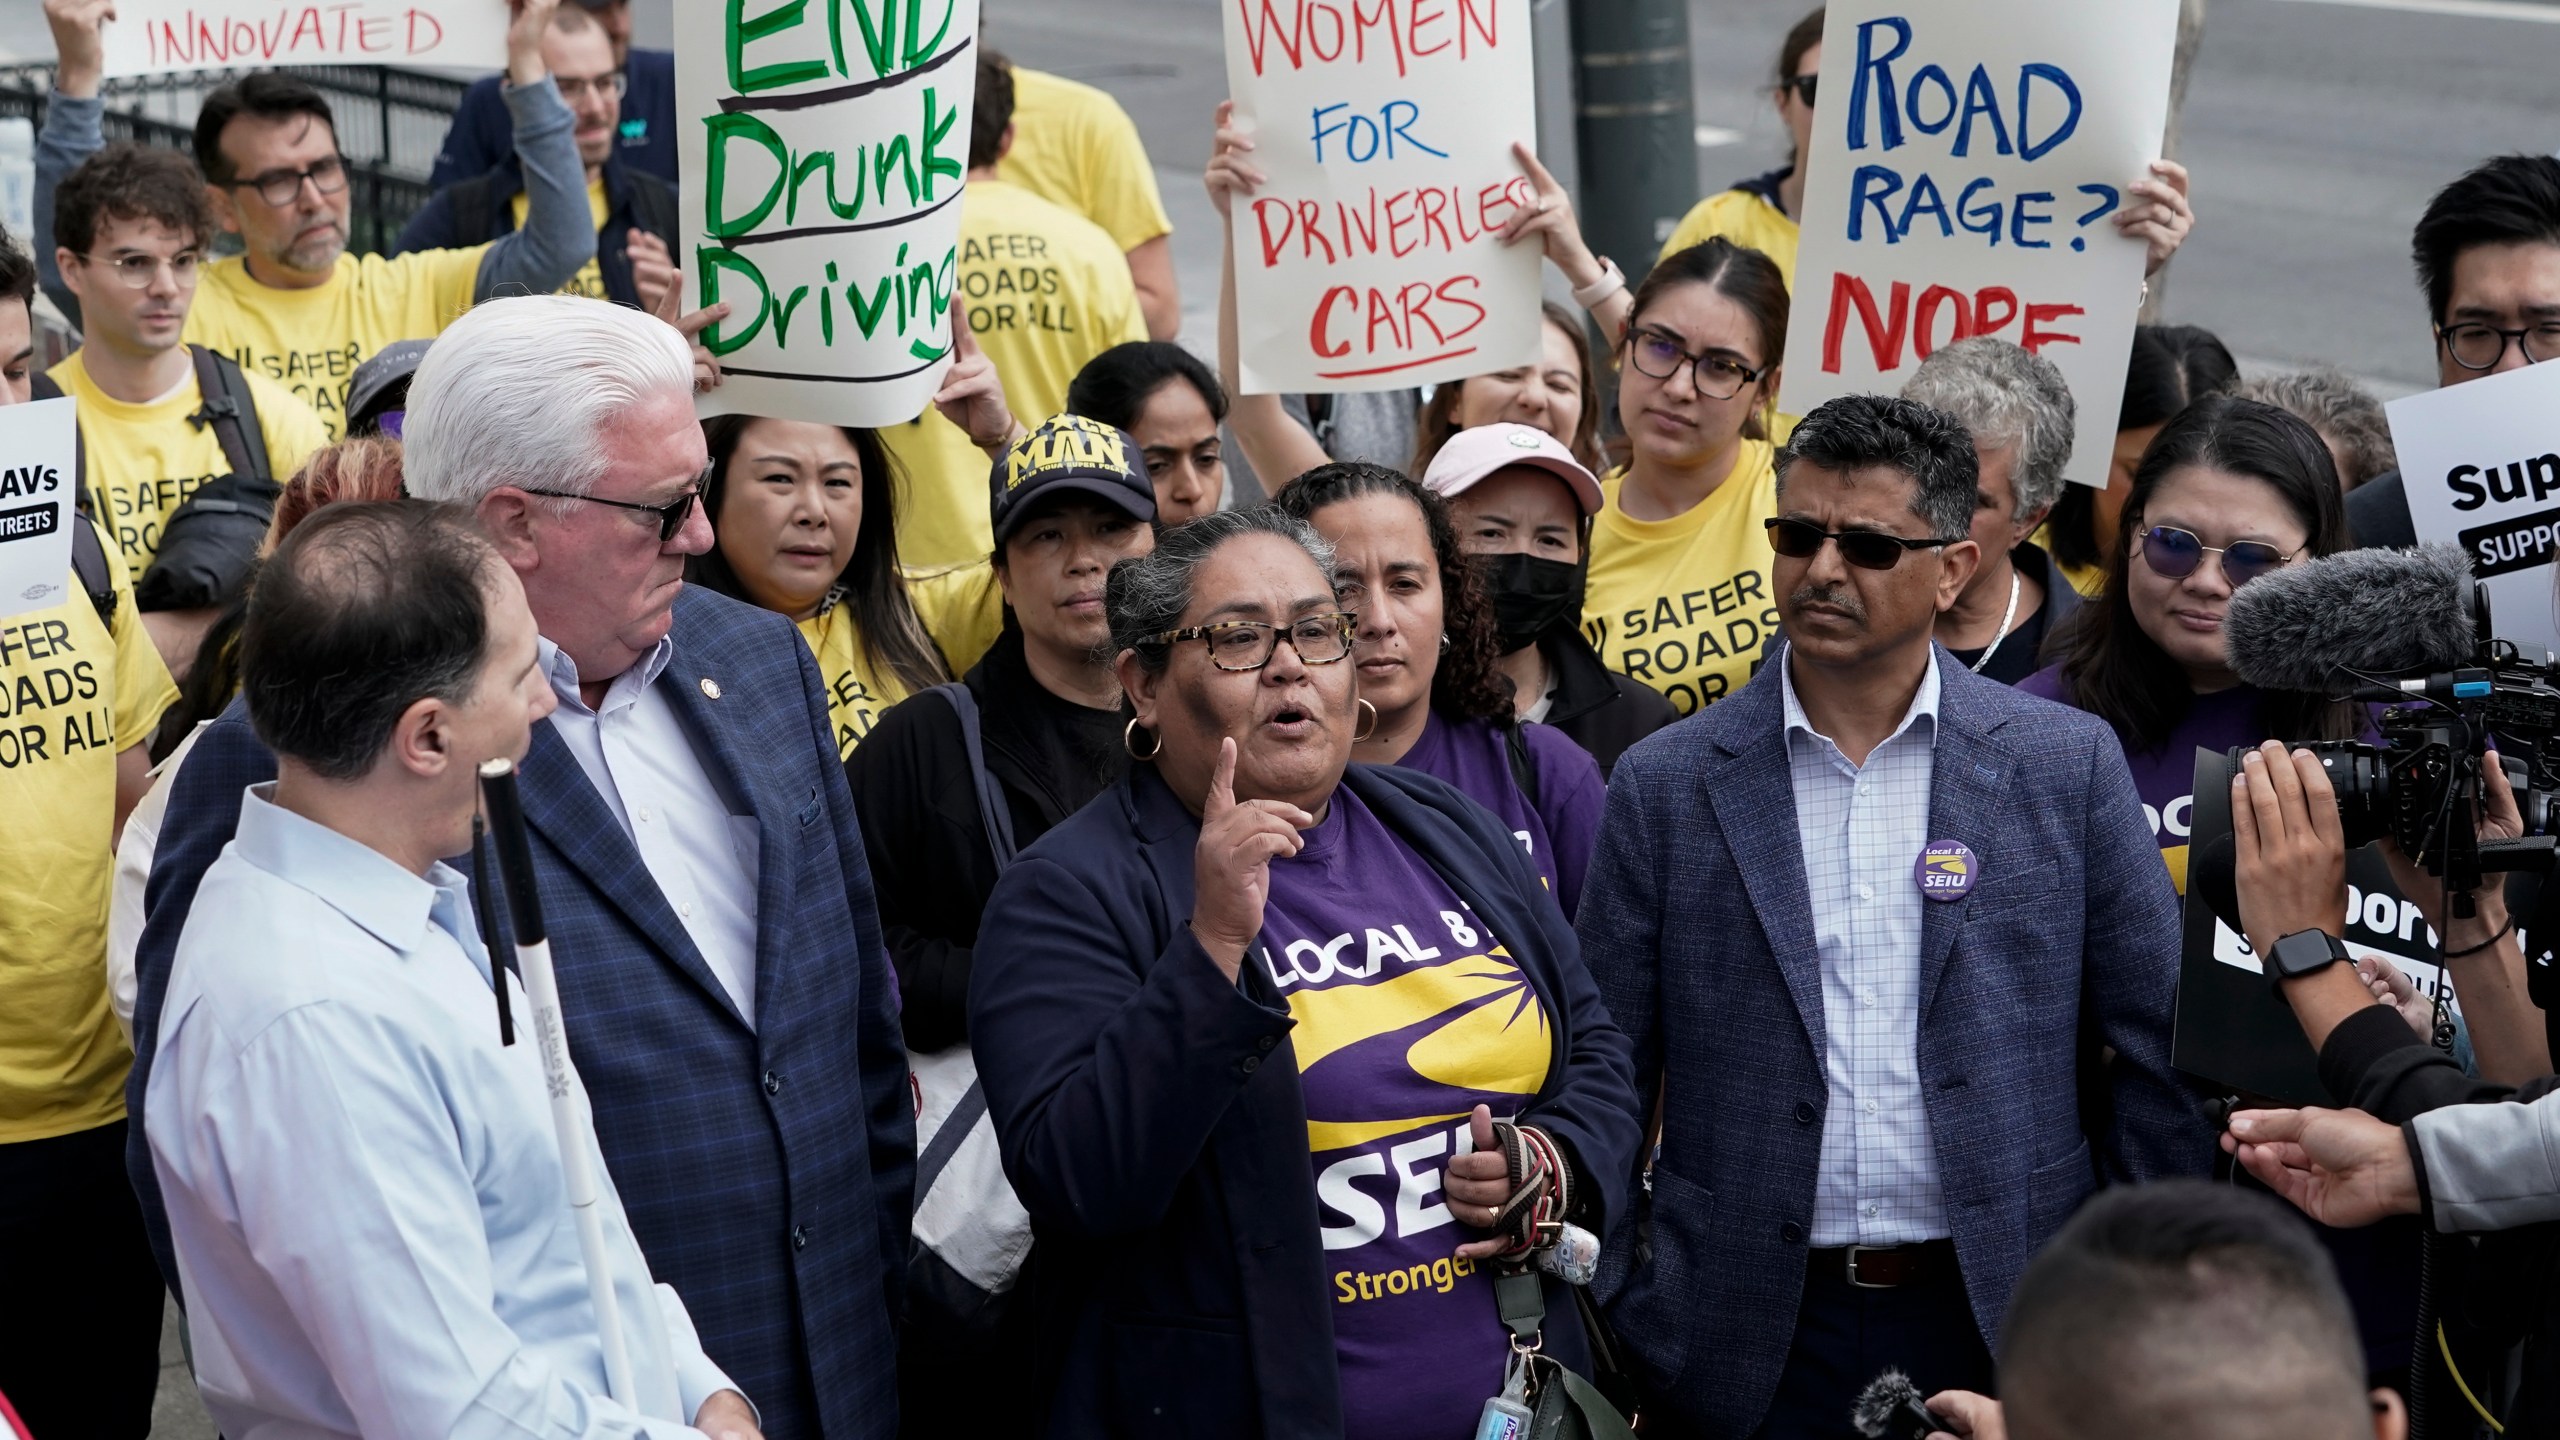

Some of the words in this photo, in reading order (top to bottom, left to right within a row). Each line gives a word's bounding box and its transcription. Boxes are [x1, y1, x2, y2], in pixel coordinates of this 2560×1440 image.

[148, 3, 442, 63] INNOVATED
[726, 0, 954, 95] END
[1239, 0, 1497, 77] WOMEN
[1847, 17, 2082, 161] ROAD
[1311, 100, 1449, 164] FOR
[703, 87, 962, 237] Drunk
[1847, 165, 2120, 252] RAGE?
[957, 234, 1048, 263] AFER
[697, 242, 957, 362] Driving
[957, 267, 1058, 298] OADS
[968, 304, 1016, 333] OR
[1310, 276, 1486, 358] CARS
[262, 342, 361, 379] SAFER
[1007, 431, 1128, 486] MAN
[111, 473, 216, 517] SAFE
[0, 510, 52, 536] TREETS
[1623, 570, 1766, 639] SAFER
[0, 620, 77, 668] FER
[1664, 672, 1730, 718] OR
[0, 724, 51, 769] OR
[1924, 875, 1967, 887] SEIU
[1262, 924, 1442, 989] LOCAL
[1334, 1255, 1476, 1304] Stronger
